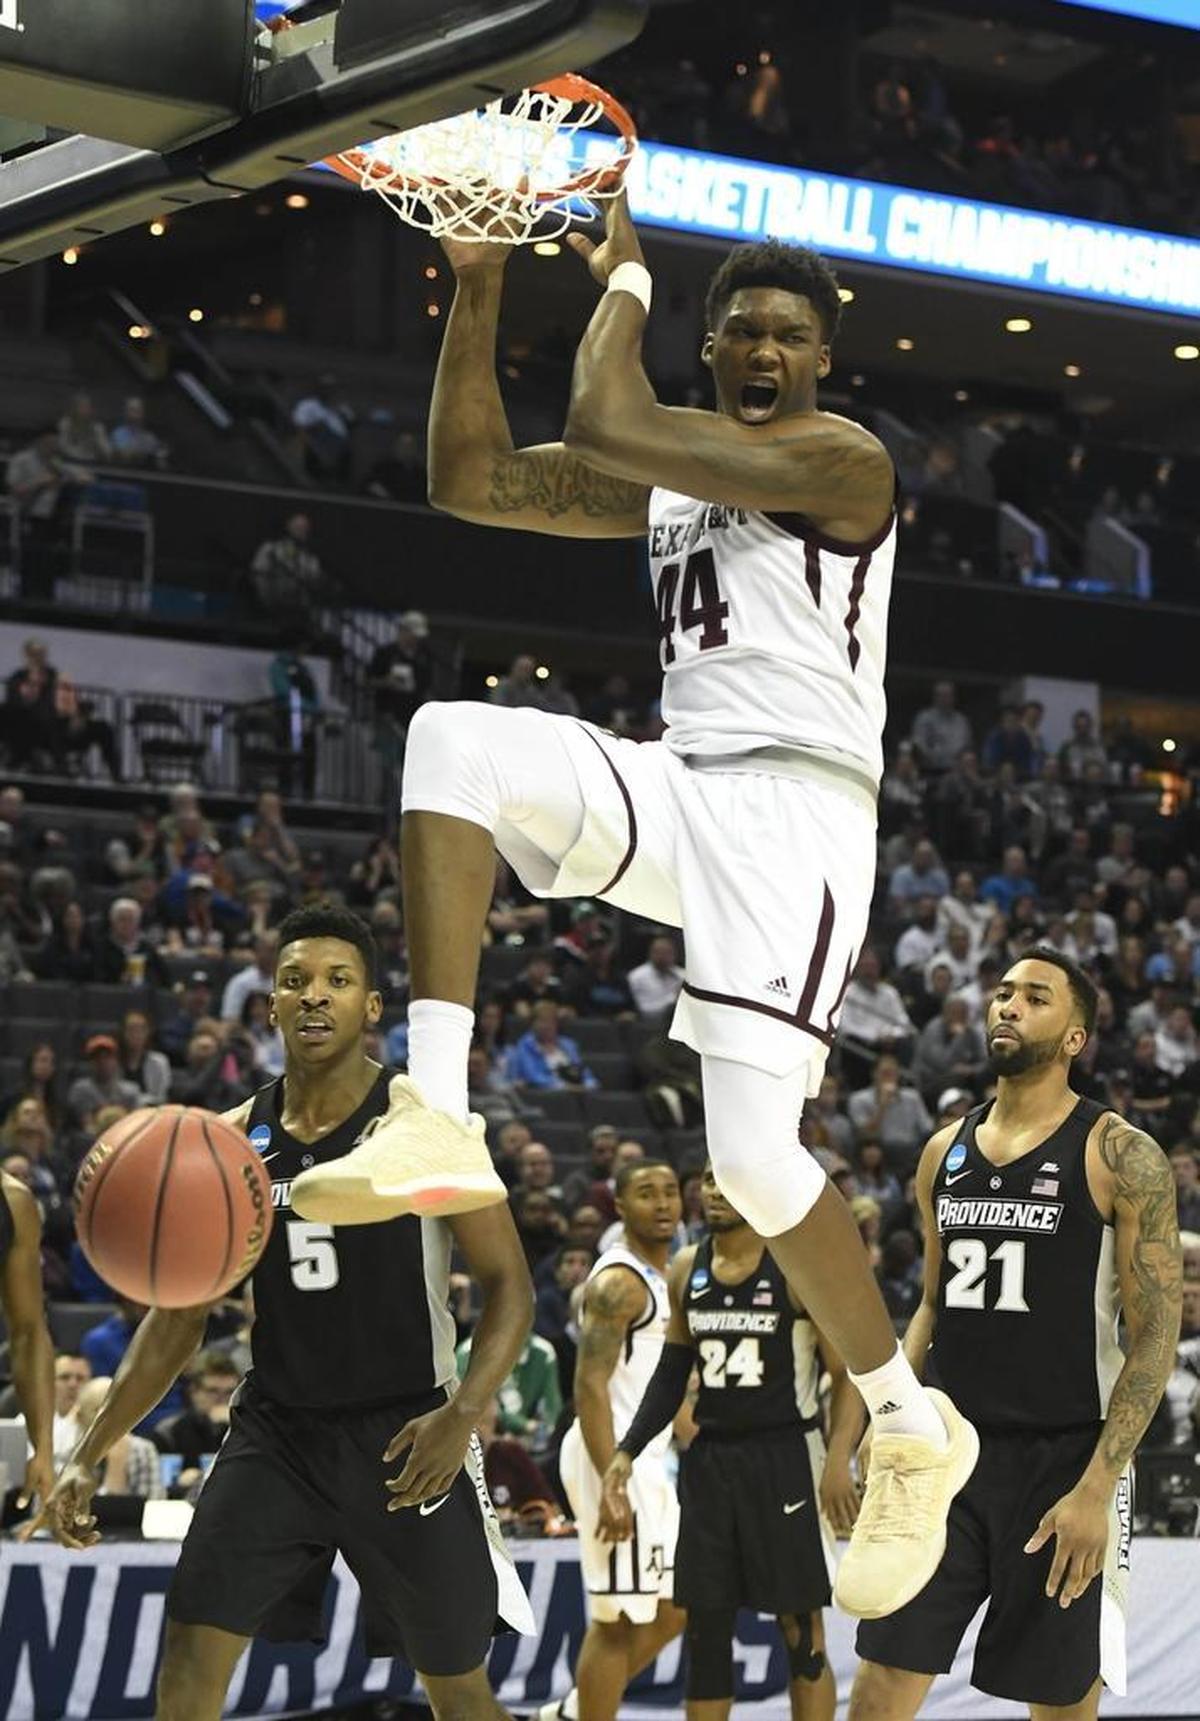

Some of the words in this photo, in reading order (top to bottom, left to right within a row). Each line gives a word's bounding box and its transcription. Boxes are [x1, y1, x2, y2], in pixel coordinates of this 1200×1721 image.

[657, 546, 730, 665] 44
[938, 1198, 1060, 1233] PROVIDENCE
[286, 1221, 340, 1292] 5
[945, 1238, 1031, 1313] 21
[687, 1309, 780, 1336] PROVIDENCE
[699, 1337, 764, 1388] 24
